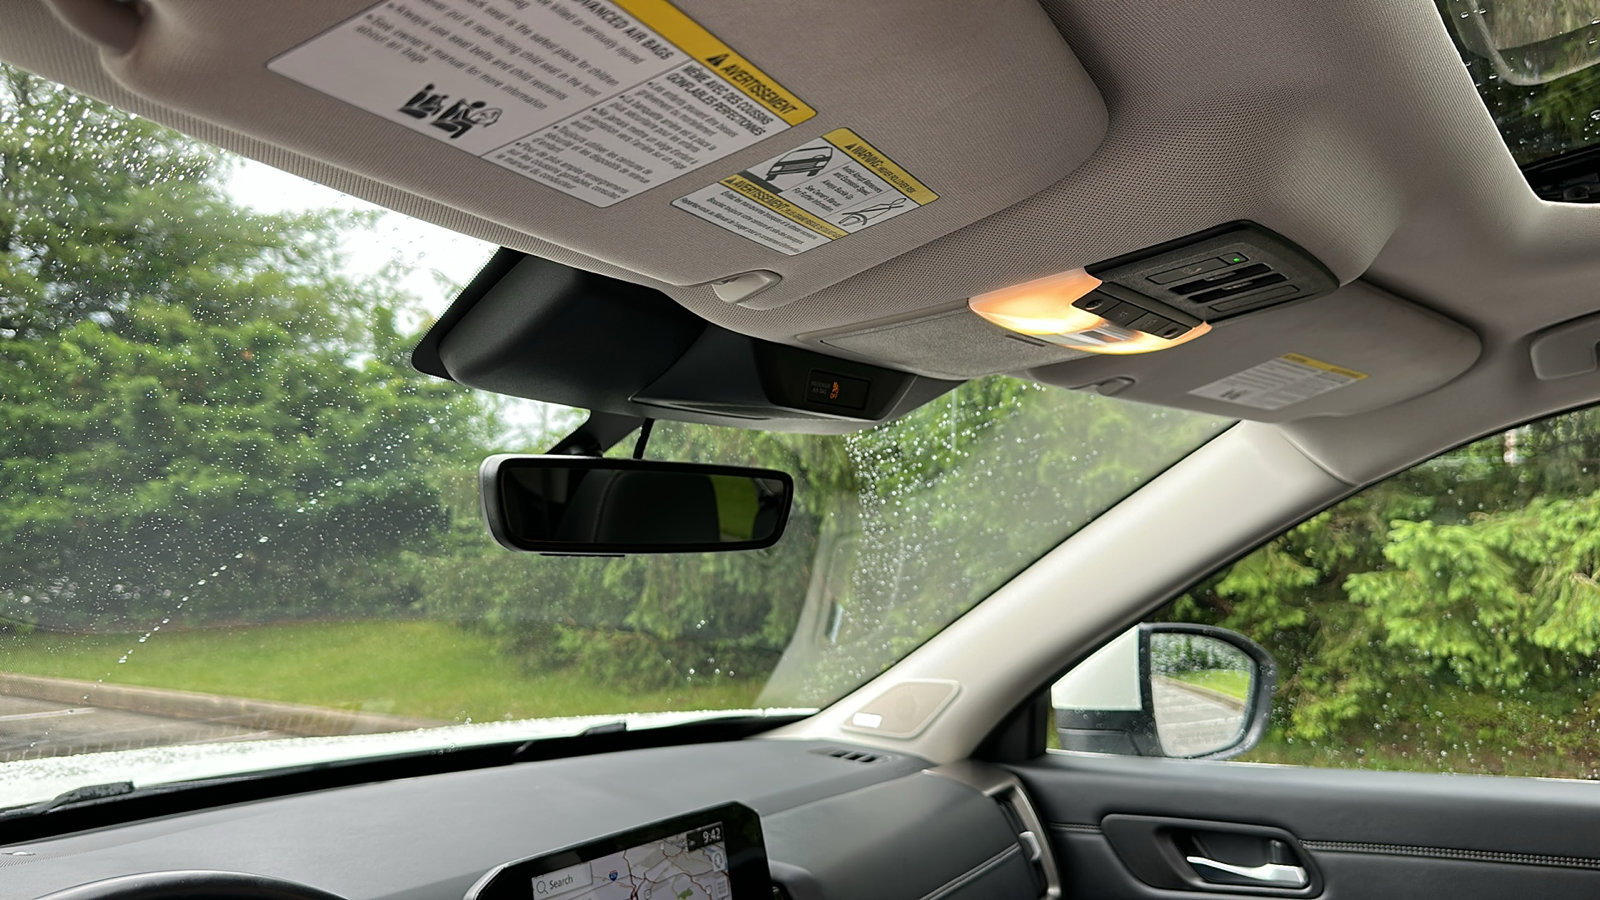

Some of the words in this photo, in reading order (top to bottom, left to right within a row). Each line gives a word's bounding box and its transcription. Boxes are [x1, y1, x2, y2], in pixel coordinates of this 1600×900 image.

[575, 0, 628, 28] VANCED
[624, 28, 647, 42] AIR
[722, 65, 795, 113] AVERTISSEMENT
[703, 828, 721, 843] 9:42
[549, 875, 574, 890] Search
